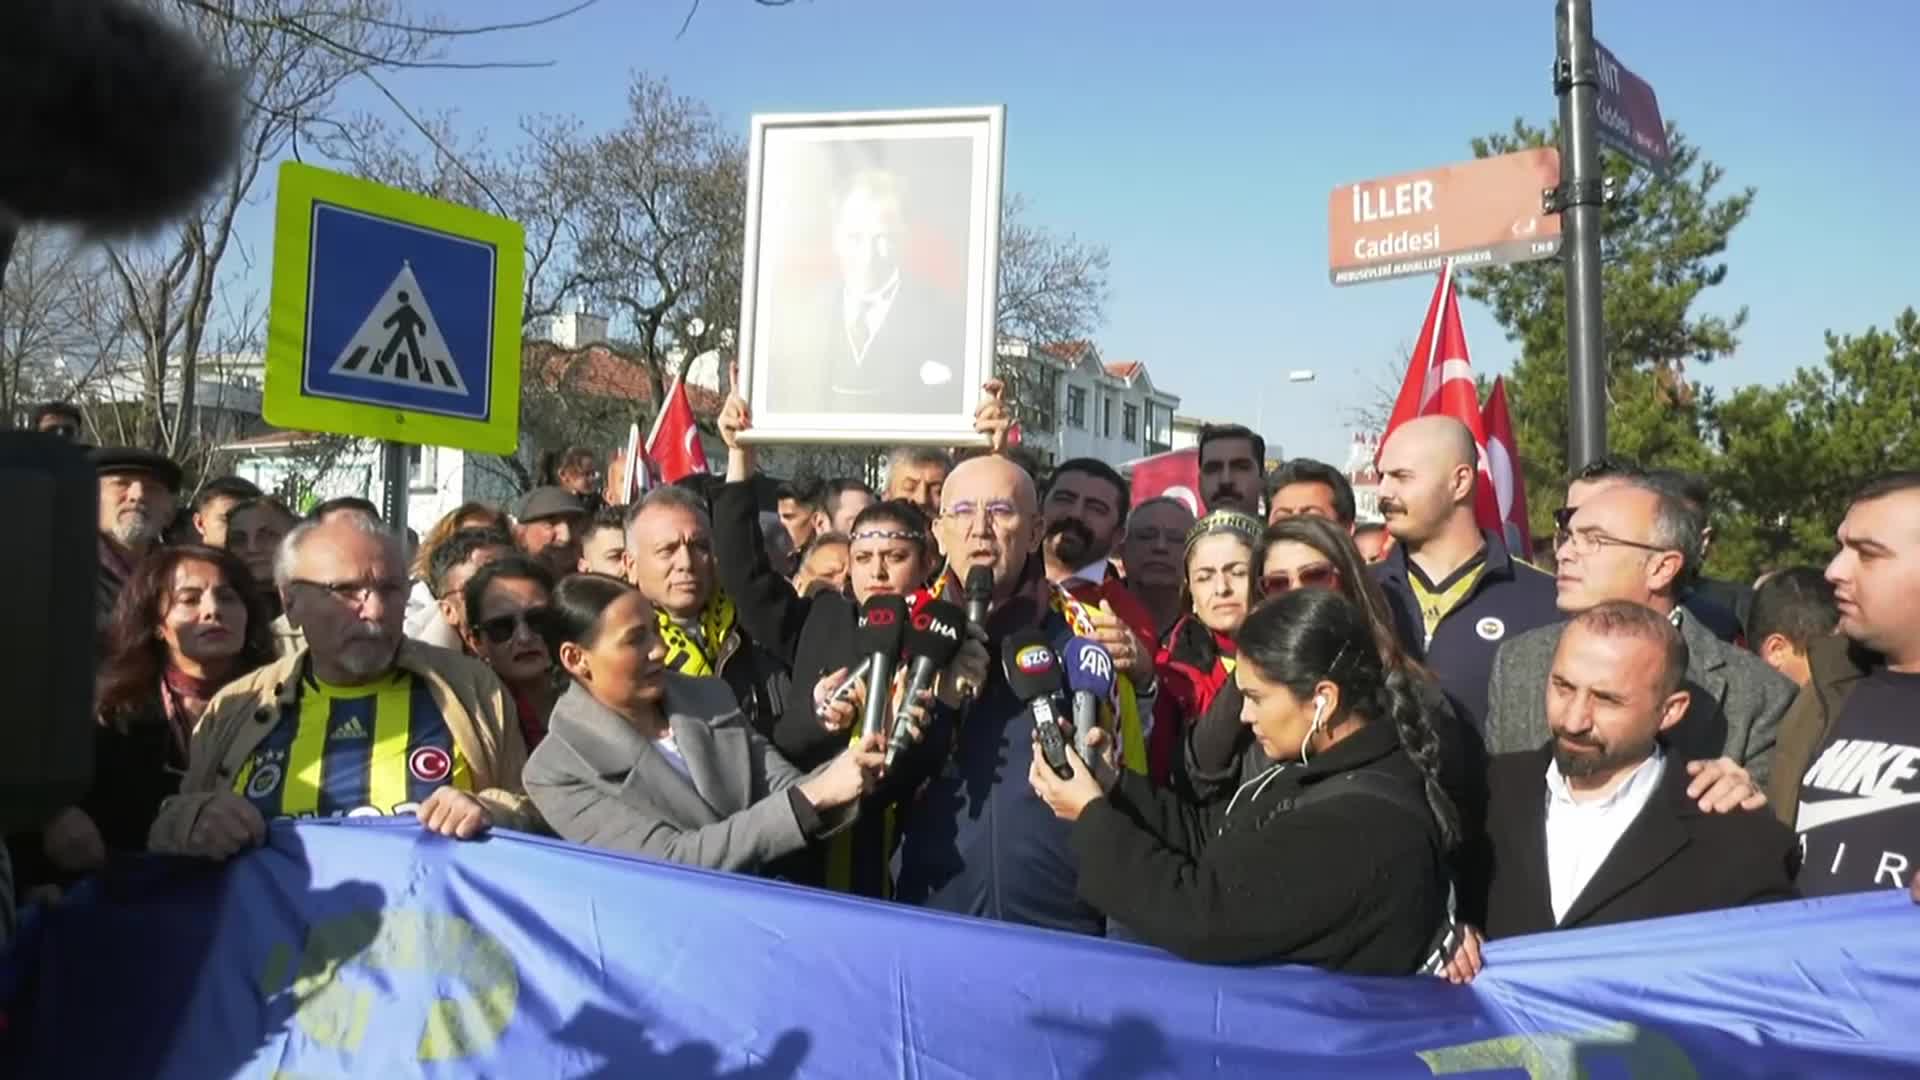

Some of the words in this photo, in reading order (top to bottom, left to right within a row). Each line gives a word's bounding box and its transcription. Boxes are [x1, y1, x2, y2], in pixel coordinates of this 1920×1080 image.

[1352, 180, 1434, 224] İLLER
[1353, 223, 1440, 260] Caddesi
[1079, 650, 1111, 681] AA
[1801, 738, 1920, 797] NIKE
[1800, 833, 1909, 889] IR
